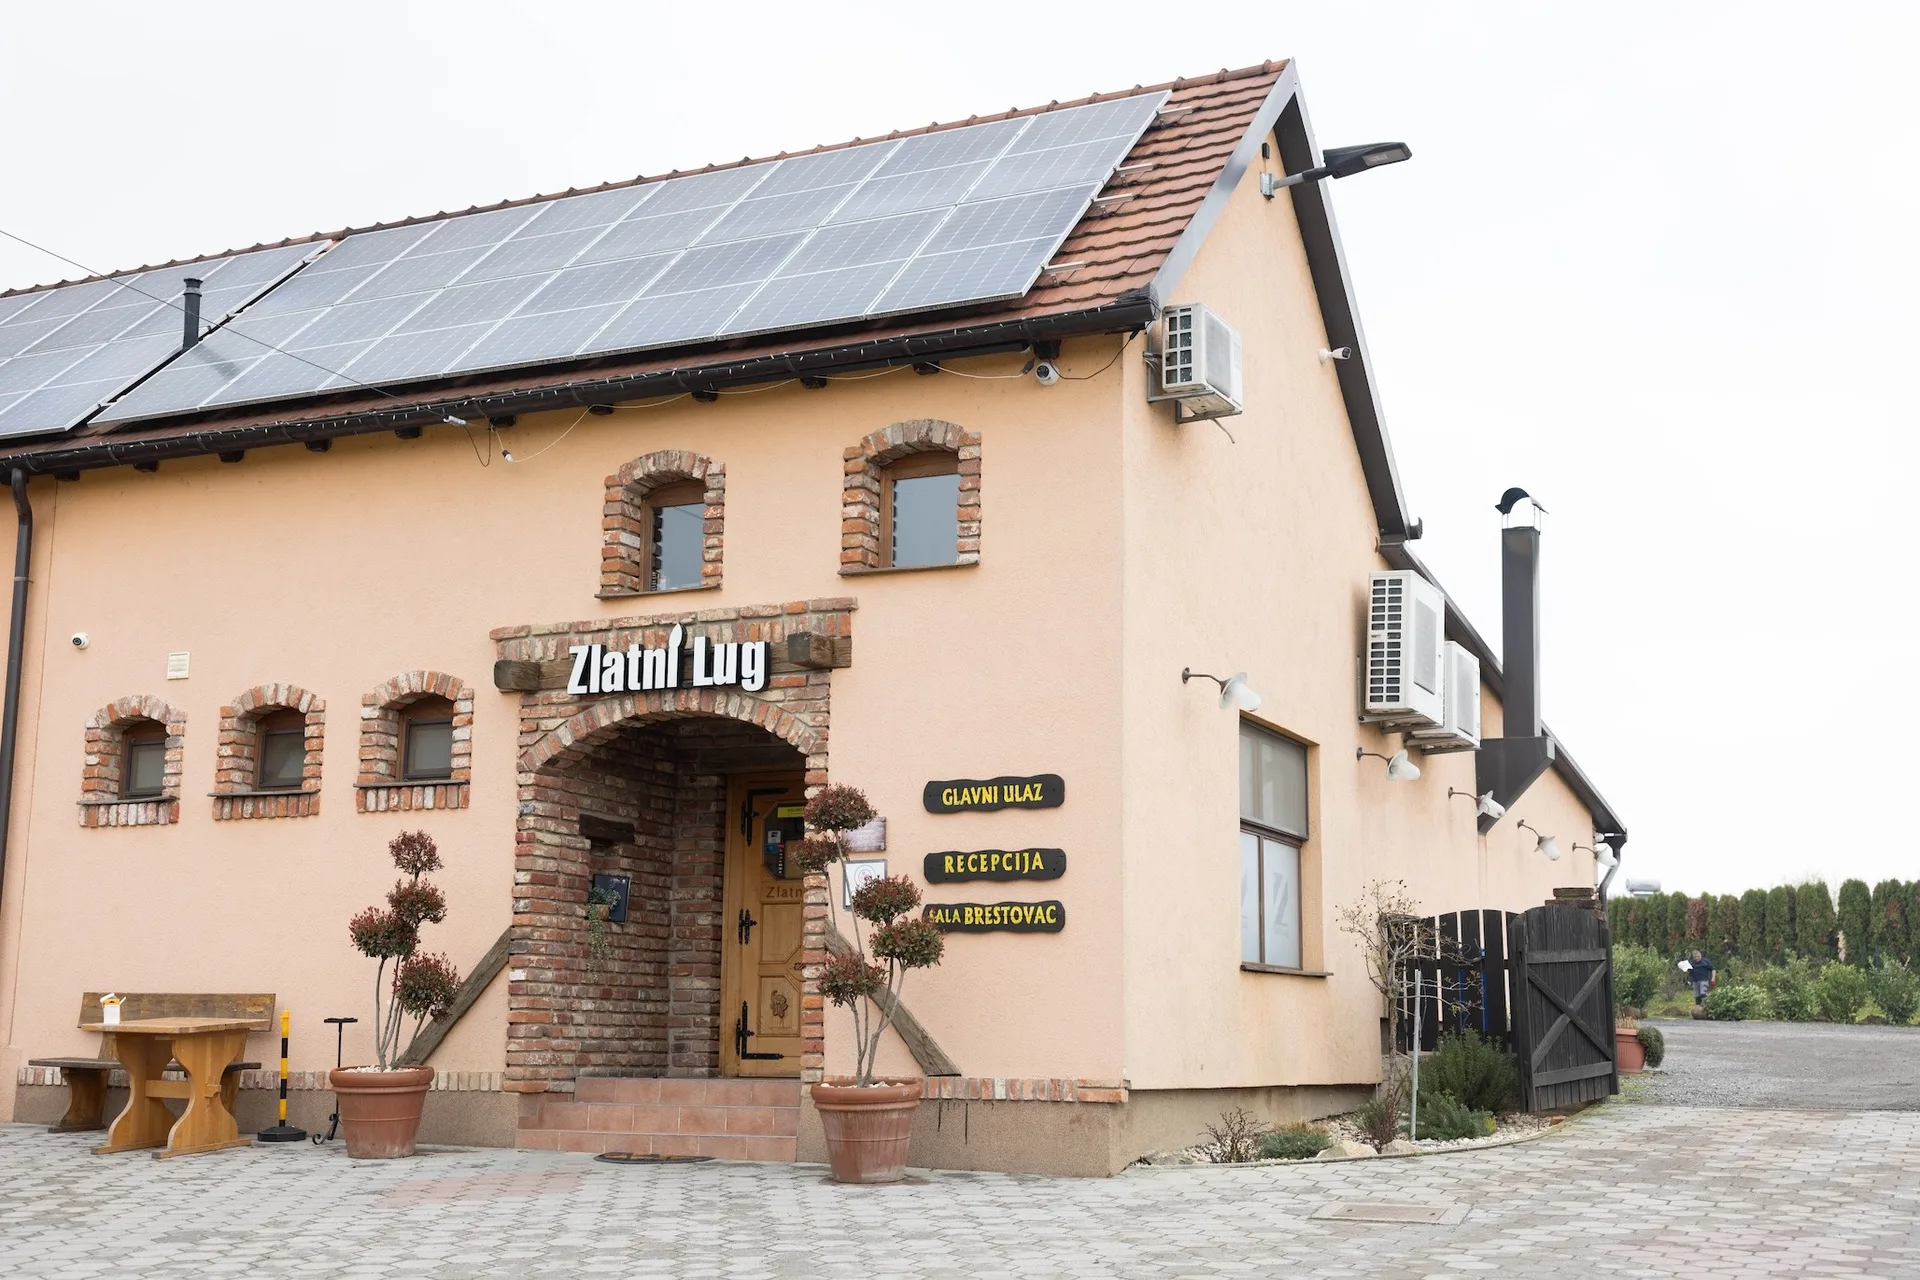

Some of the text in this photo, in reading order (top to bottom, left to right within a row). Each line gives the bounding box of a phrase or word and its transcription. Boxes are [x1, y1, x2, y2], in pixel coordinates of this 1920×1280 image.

[567, 623, 766, 695] Zlatni Lug
[942, 783, 1044, 806] GLAVNI ULAZ
[944, 852, 1044, 874] RECEPCIJA
[964, 905, 1057, 925] BRESTOVAC
